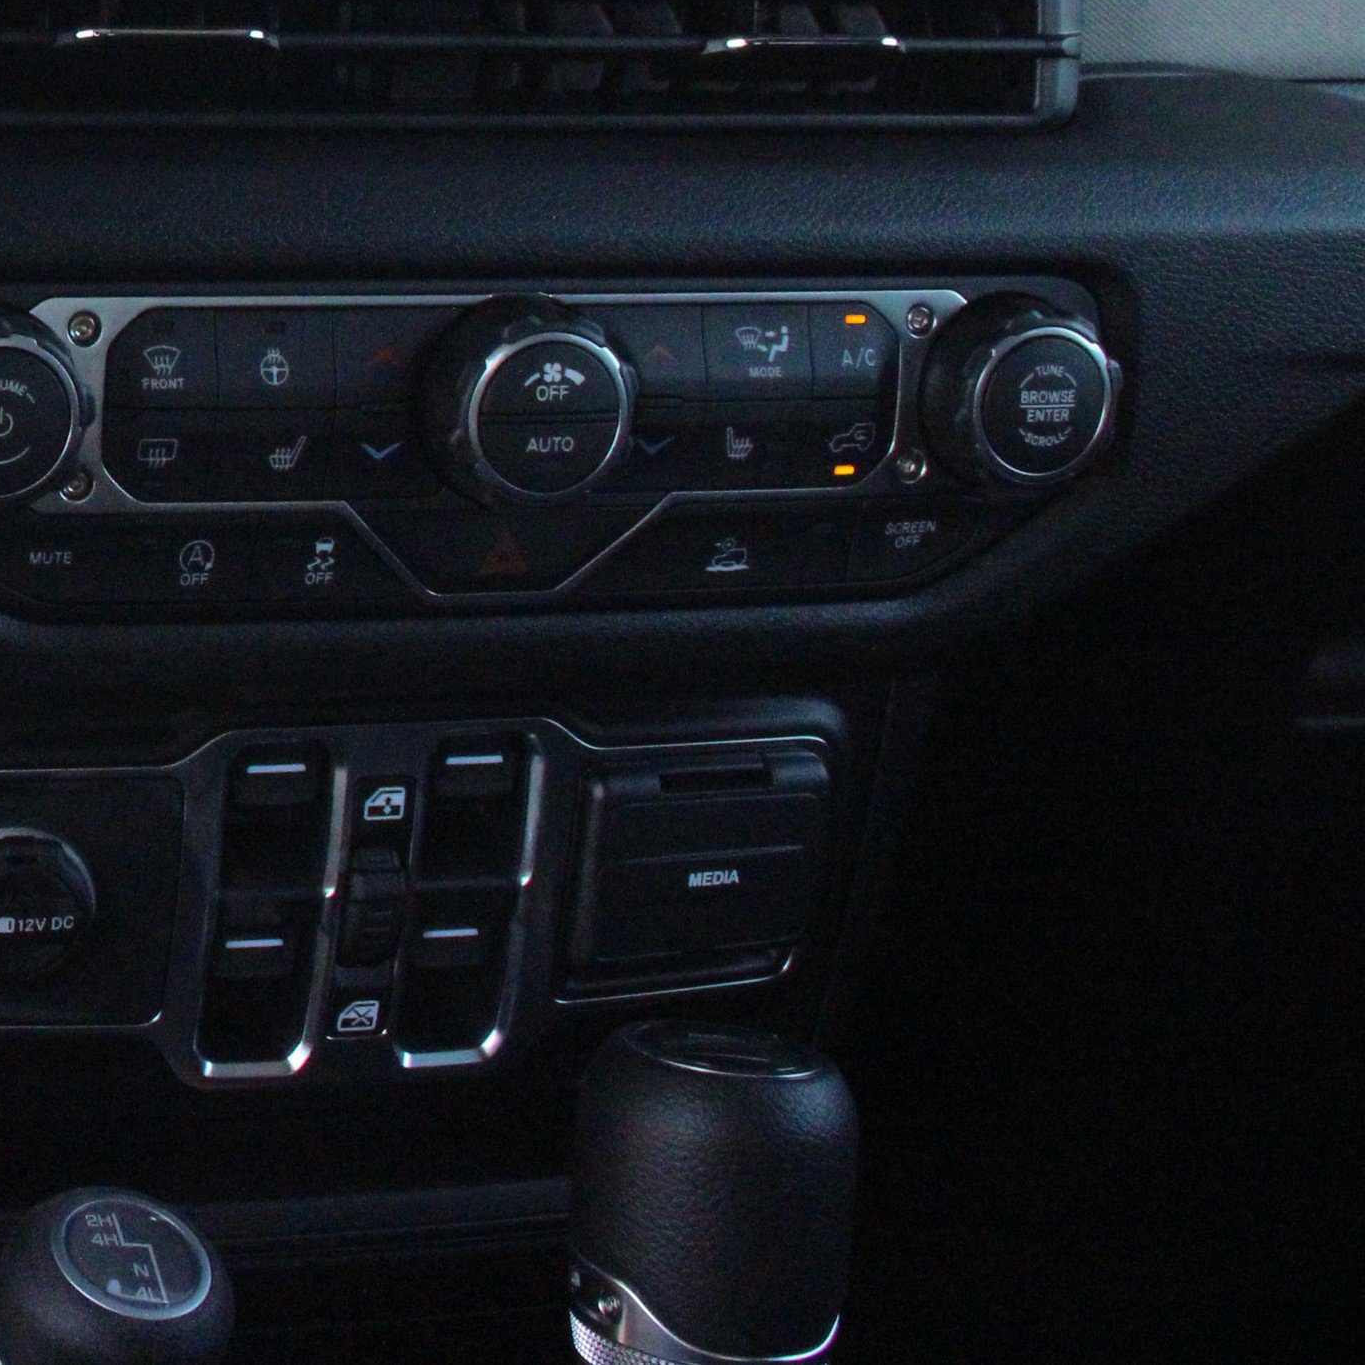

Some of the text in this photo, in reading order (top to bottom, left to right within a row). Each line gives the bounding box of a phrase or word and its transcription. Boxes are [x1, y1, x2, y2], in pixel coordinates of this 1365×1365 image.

[842, 349, 876, 368] A/C
[749, 367, 782, 377] MODE
[1035, 365, 1065, 377] TUNE
[141, 377, 185, 390] FRONT
[536, 384, 569, 402] OFF
[1021, 390, 1075, 403] BROWSE
[1026, 409, 1069, 422] ENTER
[526, 436, 575, 453] AUTO
[1025, 434, 1067, 447] SCROLL
[884, 521, 936, 535] SCREEN
[894, 534, 921, 548] OFF
[29, 551, 72, 565] MUTE
[179, 572, 208, 586] OFF
[304, 571, 333, 586] OFF
[689, 870, 739, 888] MEDIA
[16, 916, 74, 932] 12V DC
[85, 1214, 112, 1227] 2H
[91, 1233, 118, 1247] 4H
[133, 1263, 150, 1277] N
